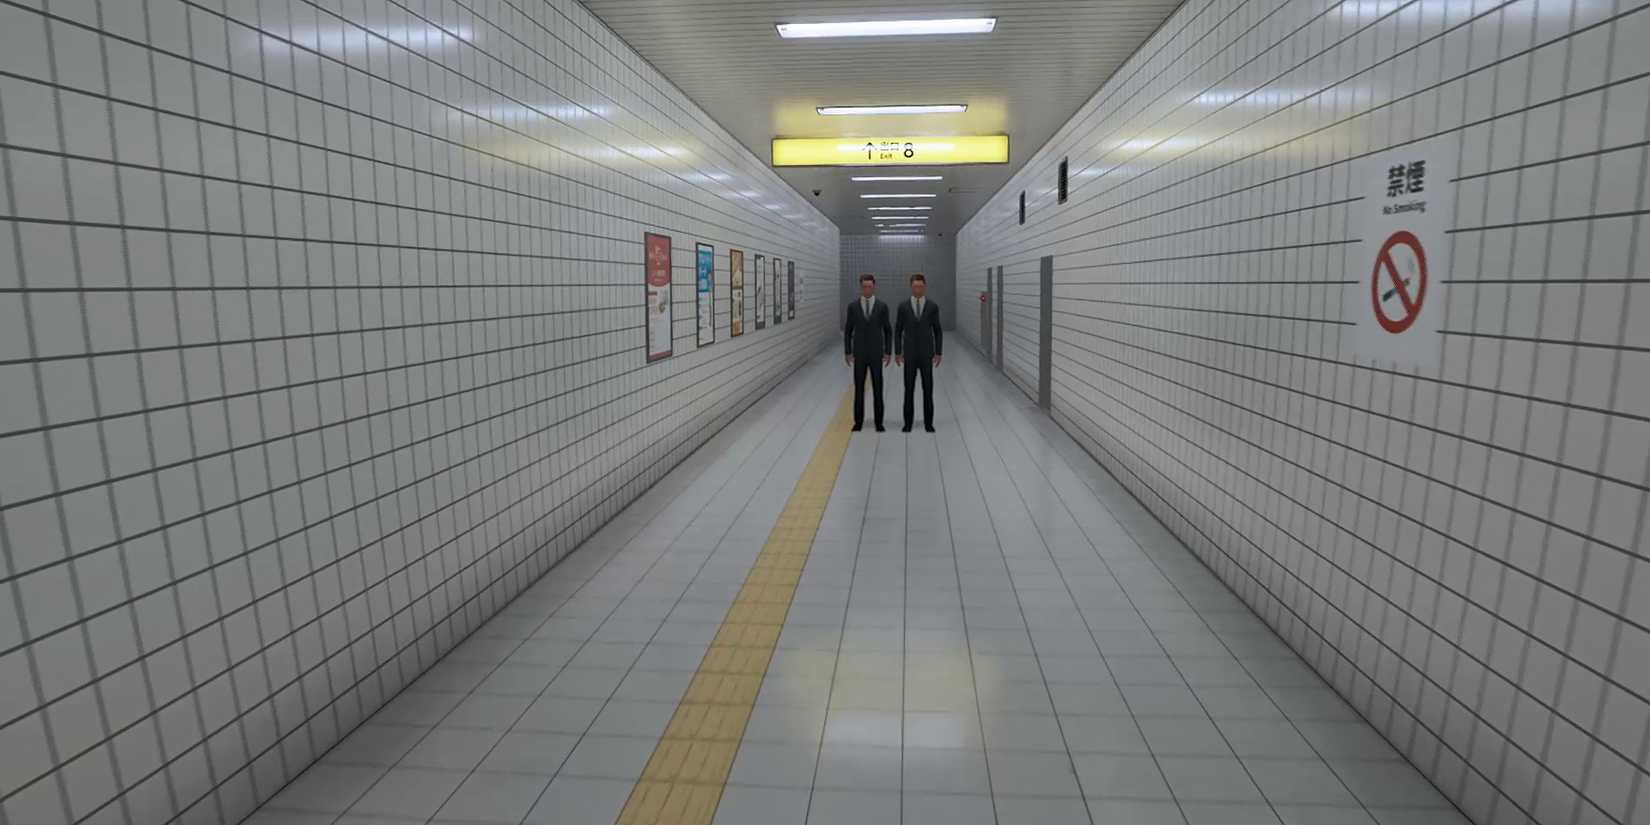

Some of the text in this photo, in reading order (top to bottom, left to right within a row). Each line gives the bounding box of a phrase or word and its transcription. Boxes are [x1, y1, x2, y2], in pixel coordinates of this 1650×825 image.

[903, 142, 914, 158] 8
[1386, 160, 1426, 198] 禁煙
[1383, 201, 1426, 215] No Smoking
